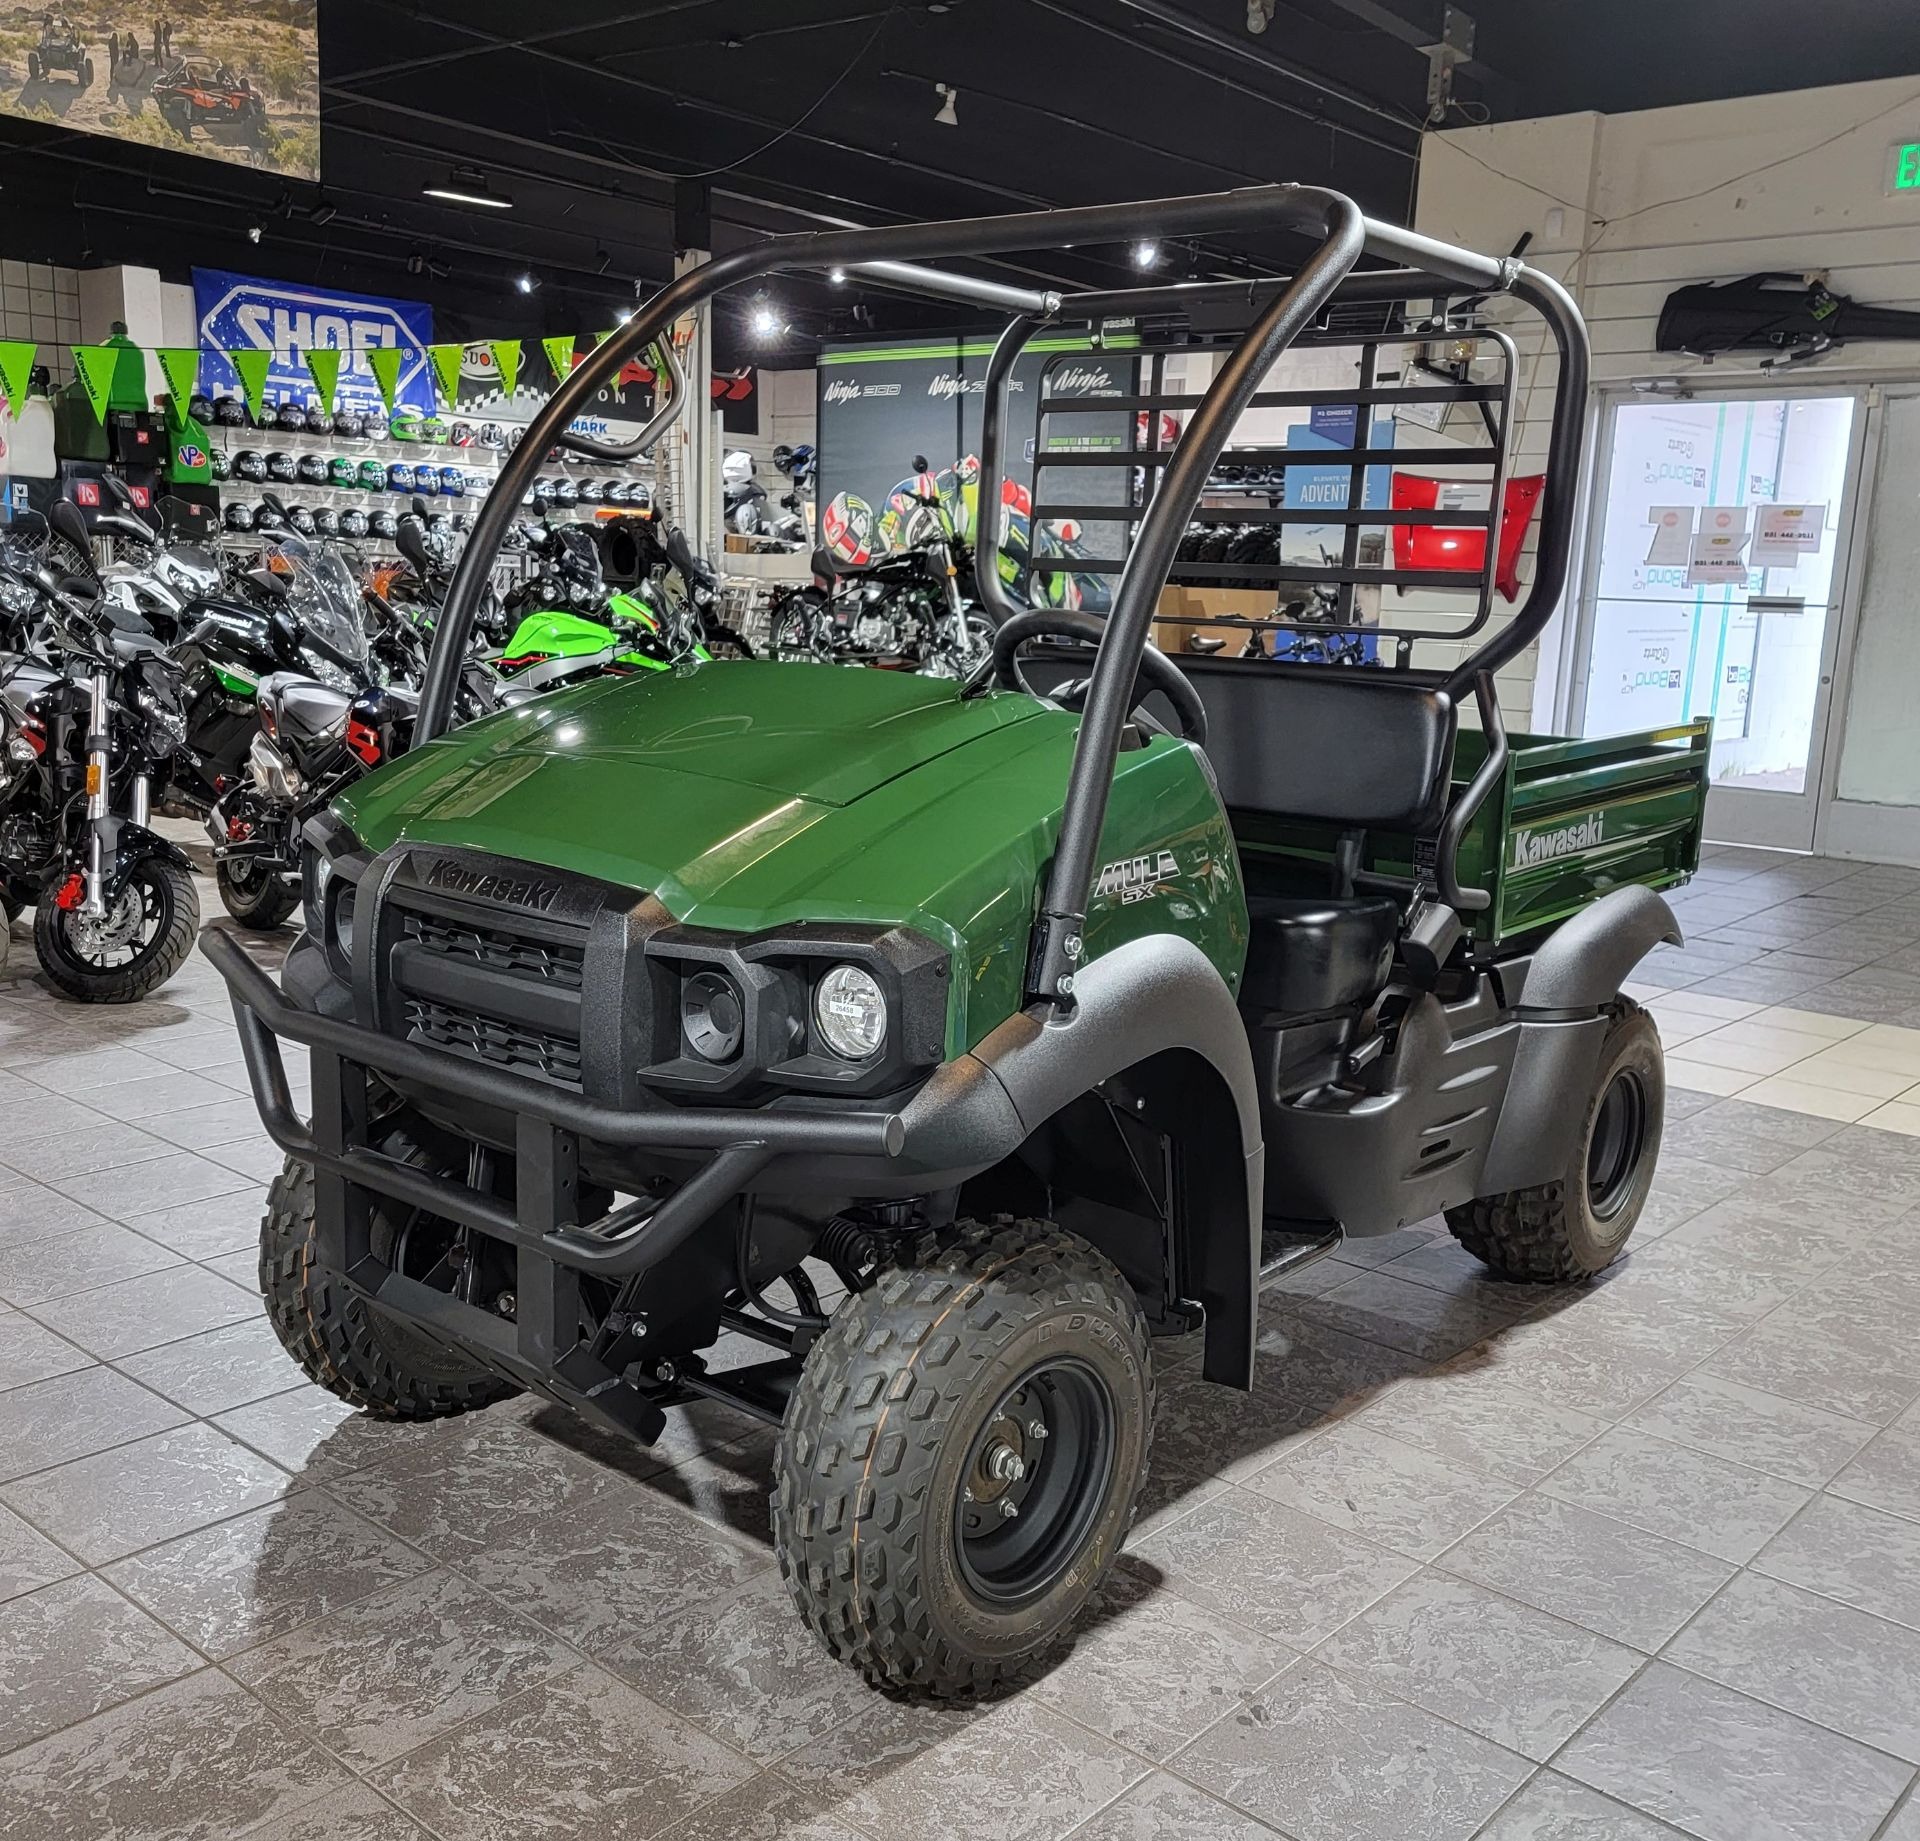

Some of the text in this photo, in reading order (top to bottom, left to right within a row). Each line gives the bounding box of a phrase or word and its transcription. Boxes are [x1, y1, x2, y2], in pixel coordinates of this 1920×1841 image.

[75, 351, 99, 400] Kawasaki
[158, 354, 182, 401] Kawasaki
[232, 355, 254, 401] Kawasaki
[305, 355, 327, 399] Kawasaki
[368, 354, 389, 397] Kawasaki
[430, 351, 451, 393] Kawasaki
[462, 350, 497, 367] SUO
[489, 344, 509, 385] Kawasaki
[545, 344, 564, 380] Kawasak
[824, 379, 861, 406] Ninja
[928, 373, 970, 400] Ninja
[1053, 366, 1112, 396] Ninja
[571, 419, 608, 434] HARK
[179, 445, 199, 467] VP
[1301, 483, 1371, 502] ADVENTE
[1515, 811, 1604, 866] Kawasaki
[428, 859, 562, 912] Kawasaki
[1094, 849, 1181, 897] MULE
[1122, 883, 1156, 905] SX
